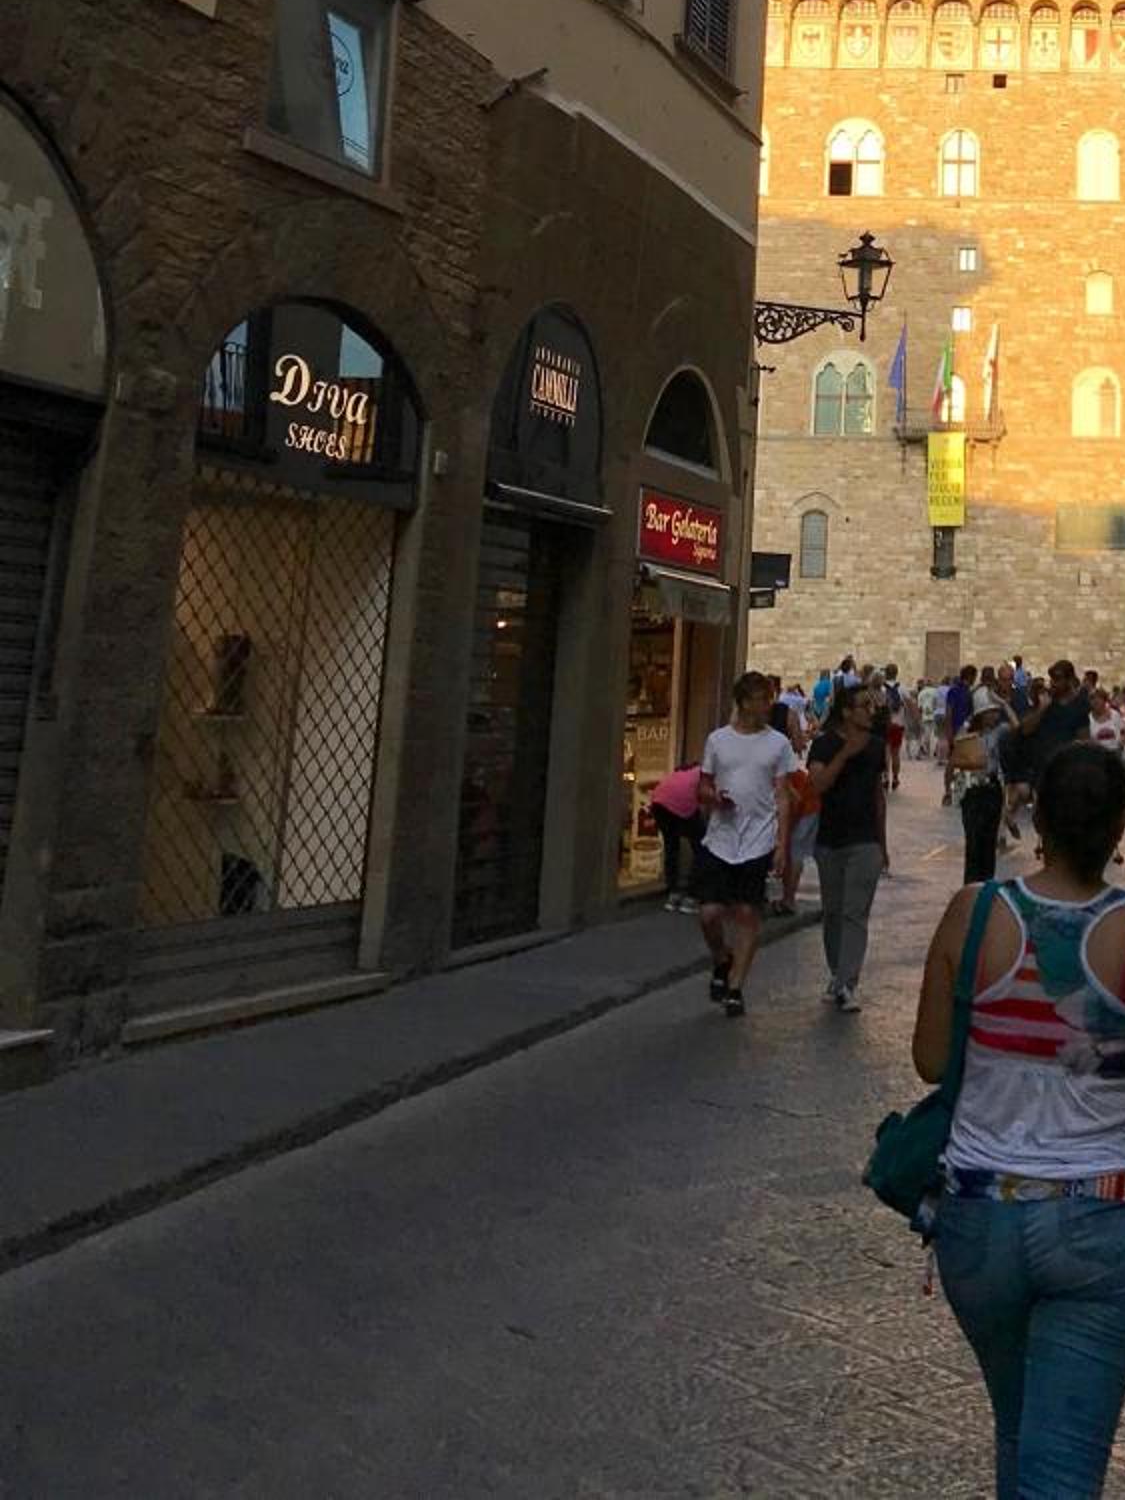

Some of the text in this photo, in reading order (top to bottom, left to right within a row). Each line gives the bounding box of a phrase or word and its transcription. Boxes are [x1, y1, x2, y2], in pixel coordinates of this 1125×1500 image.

[285, 422, 347, 459] SHOES
[645, 503, 717, 545] Bar Gelateria
[637, 724, 669, 740] BAR
